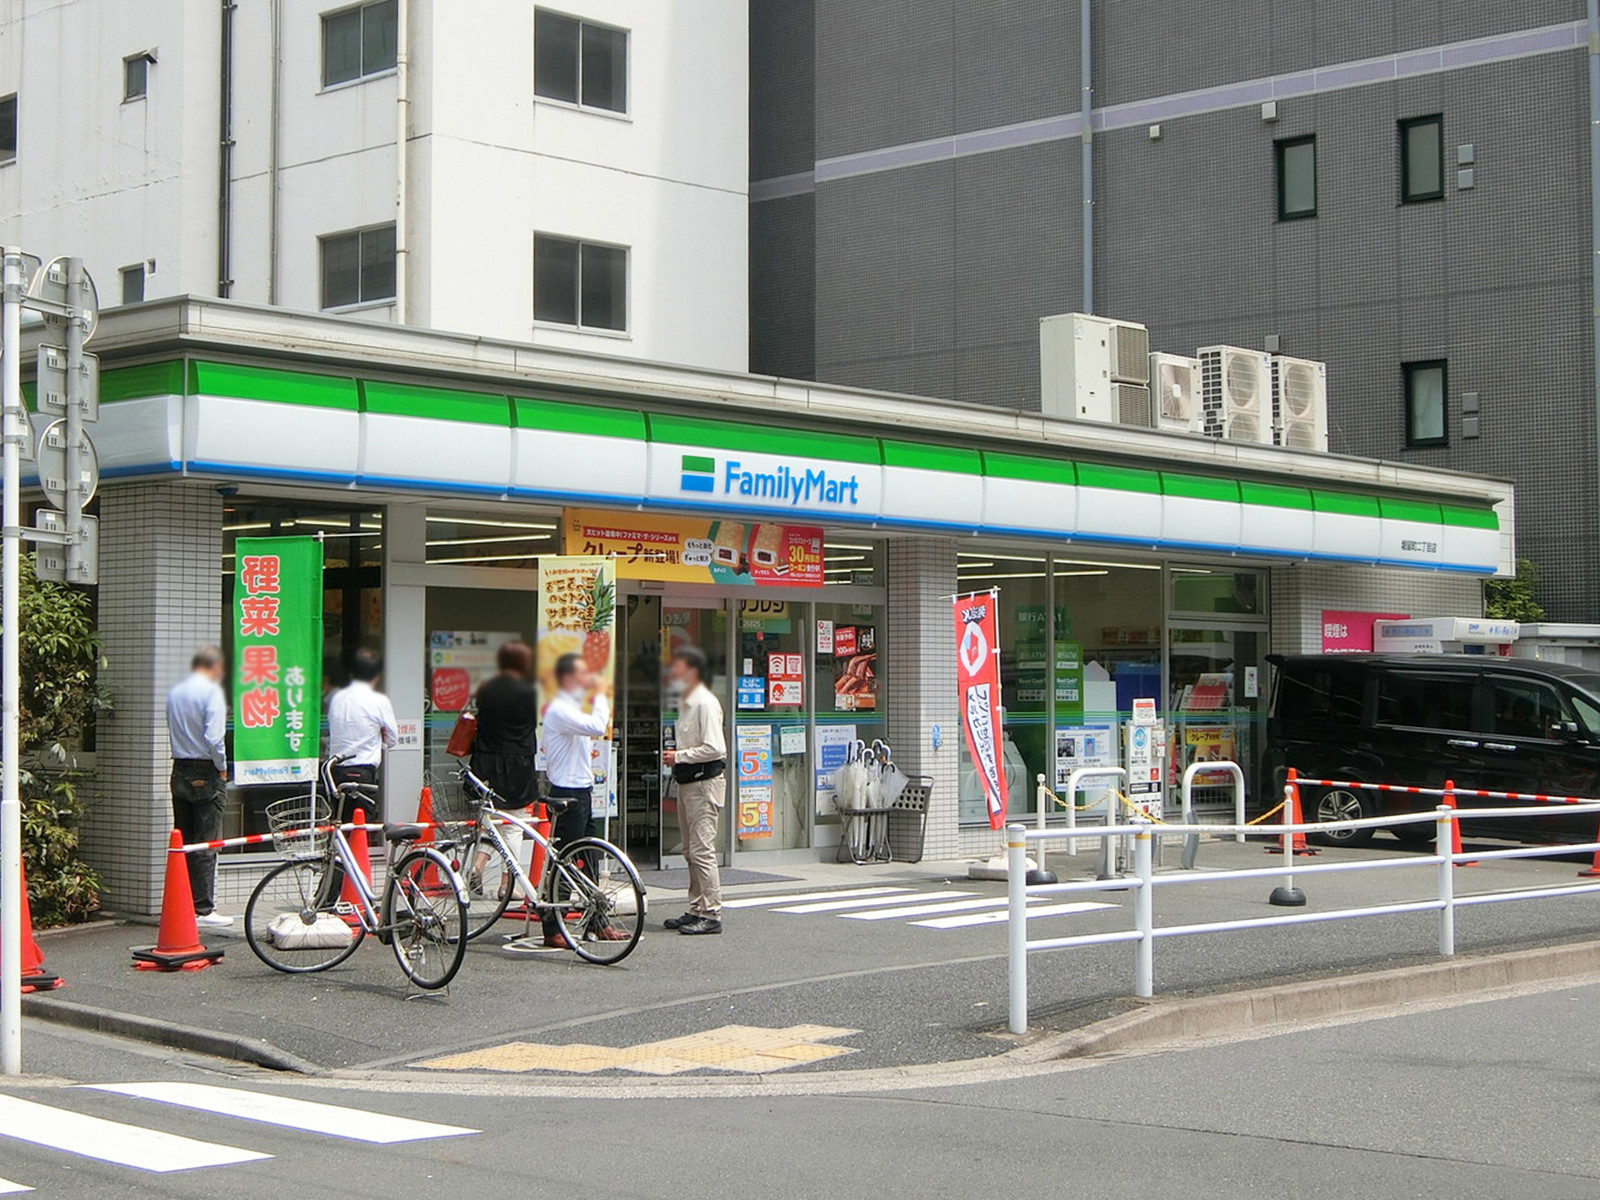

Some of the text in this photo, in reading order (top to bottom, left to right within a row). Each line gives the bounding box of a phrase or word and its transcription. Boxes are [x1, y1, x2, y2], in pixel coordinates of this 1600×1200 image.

[725, 460, 858, 505] FamilyMart
[742, 678, 761, 688] たばこ
[398, 724, 417, 735] 煙所
